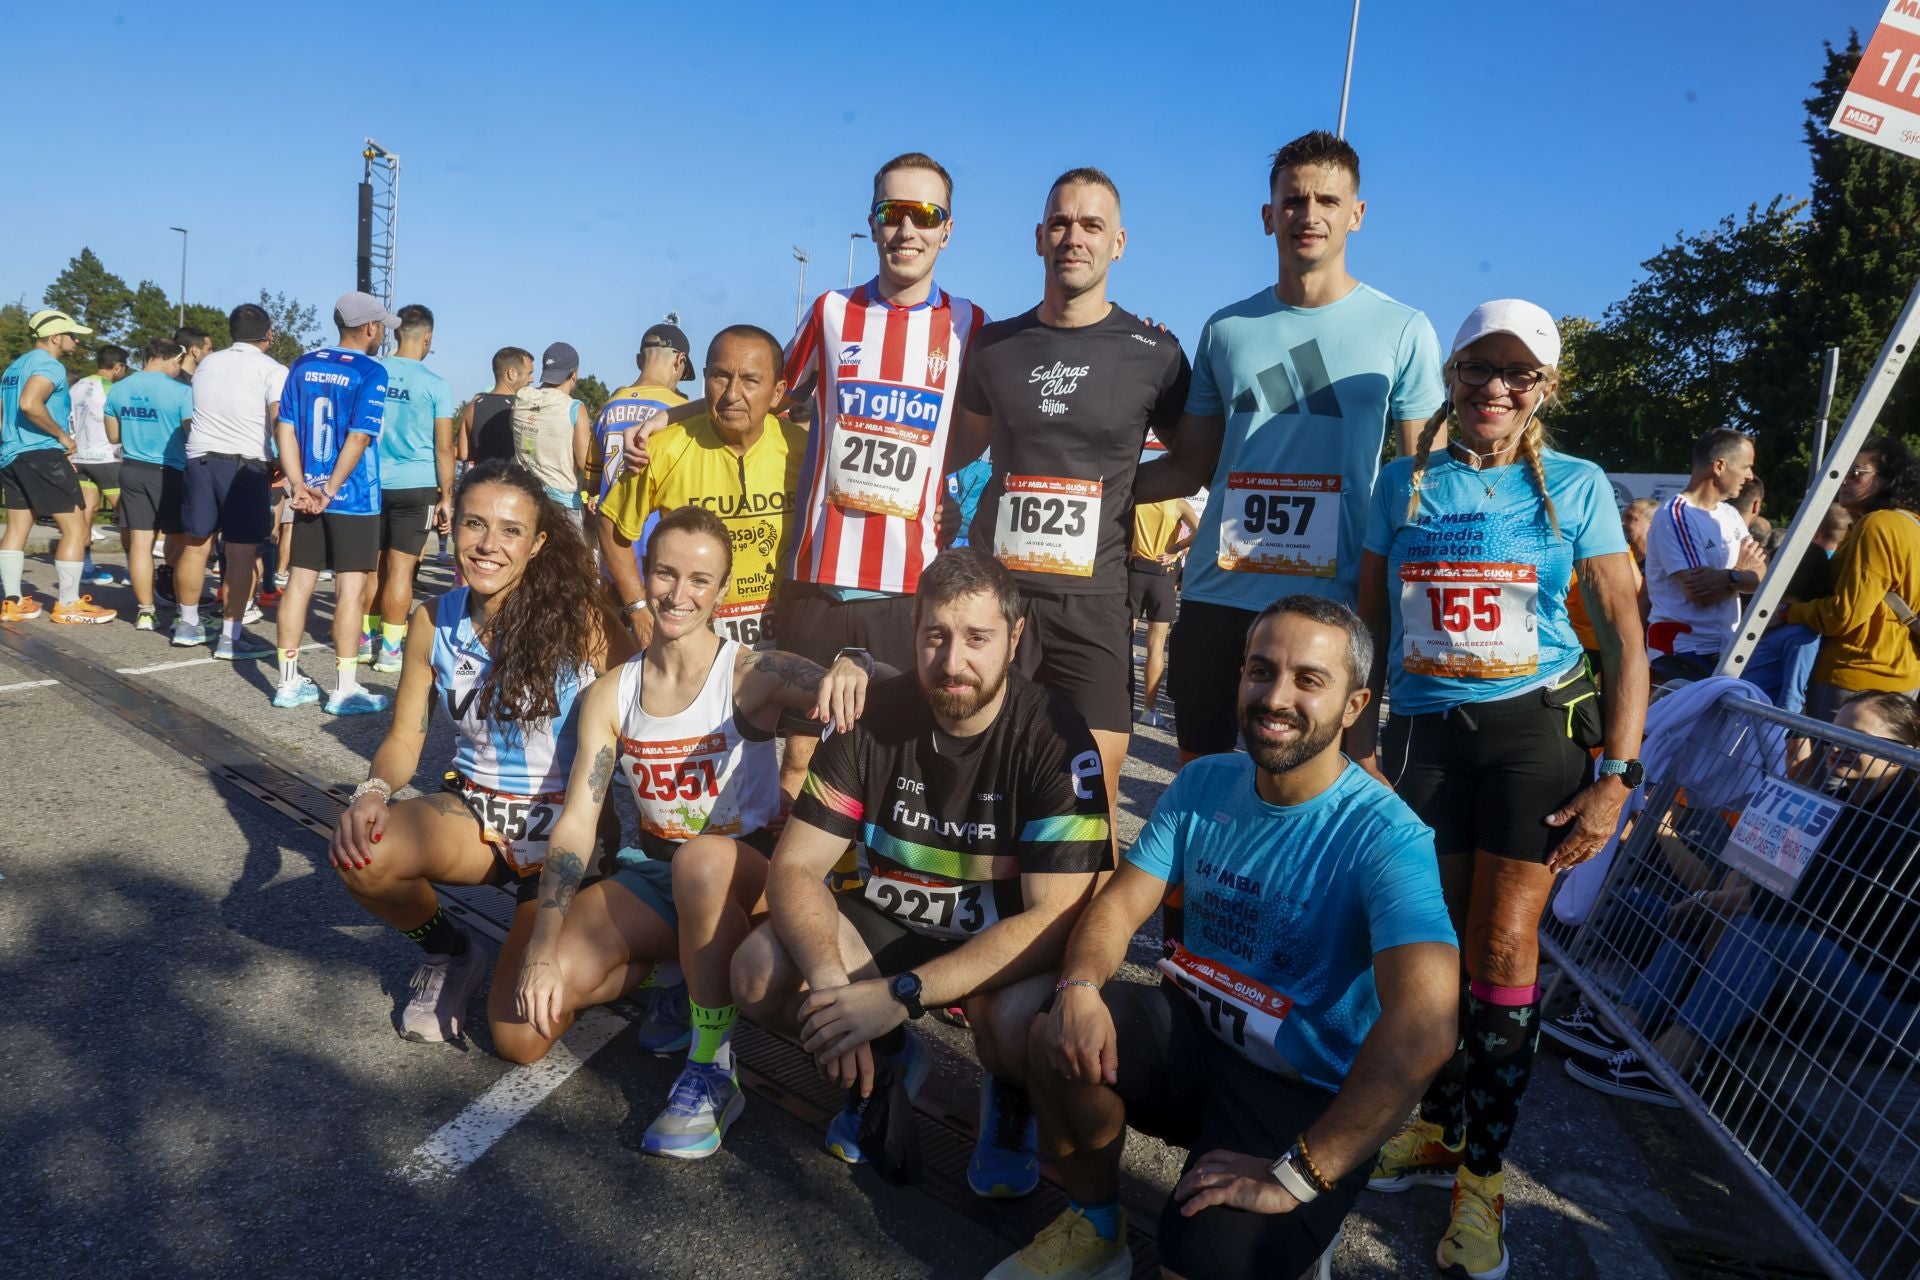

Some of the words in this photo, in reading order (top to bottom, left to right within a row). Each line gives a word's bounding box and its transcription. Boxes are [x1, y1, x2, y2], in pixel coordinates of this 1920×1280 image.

[1844, 109, 1878, 129] MBA
[1029, 361, 1090, 383] Salinas
[387, 387, 411, 401] BA
[1041, 379, 1077, 396] Club
[121, 406, 158, 419] MBA
[871, 389, 938, 422] gijón
[312, 397, 333, 462] 6
[865, 423, 884, 432] MBA
[840, 436, 917, 482] 2130
[1298, 479, 1322, 487] GIJÓN
[1010, 496, 1088, 537] 1623
[1244, 494, 1316, 536] 957
[1440, 512, 1486, 524] MBA
[730, 526, 765, 545] asaje
[1427, 528, 1485, 541] media
[1407, 543, 1483, 557] maratón
[737, 573, 768, 585] molly
[1484, 568, 1513, 578] GIJÓN
[738, 581, 776, 595] brunch
[741, 604, 760, 612] MBA
[1426, 588, 1502, 632] 155
[642, 746, 663, 755] MBA
[632, 759, 719, 801] 2551
[1749, 781, 1838, 838] VYCAS
[1217, 870, 1261, 898] MBA
[877, 883, 984, 933] 2273
[1204, 890, 1259, 921] media
[1203, 926, 1253, 962] GIJÓN
[1234, 981, 1266, 1004] GIJÓN
